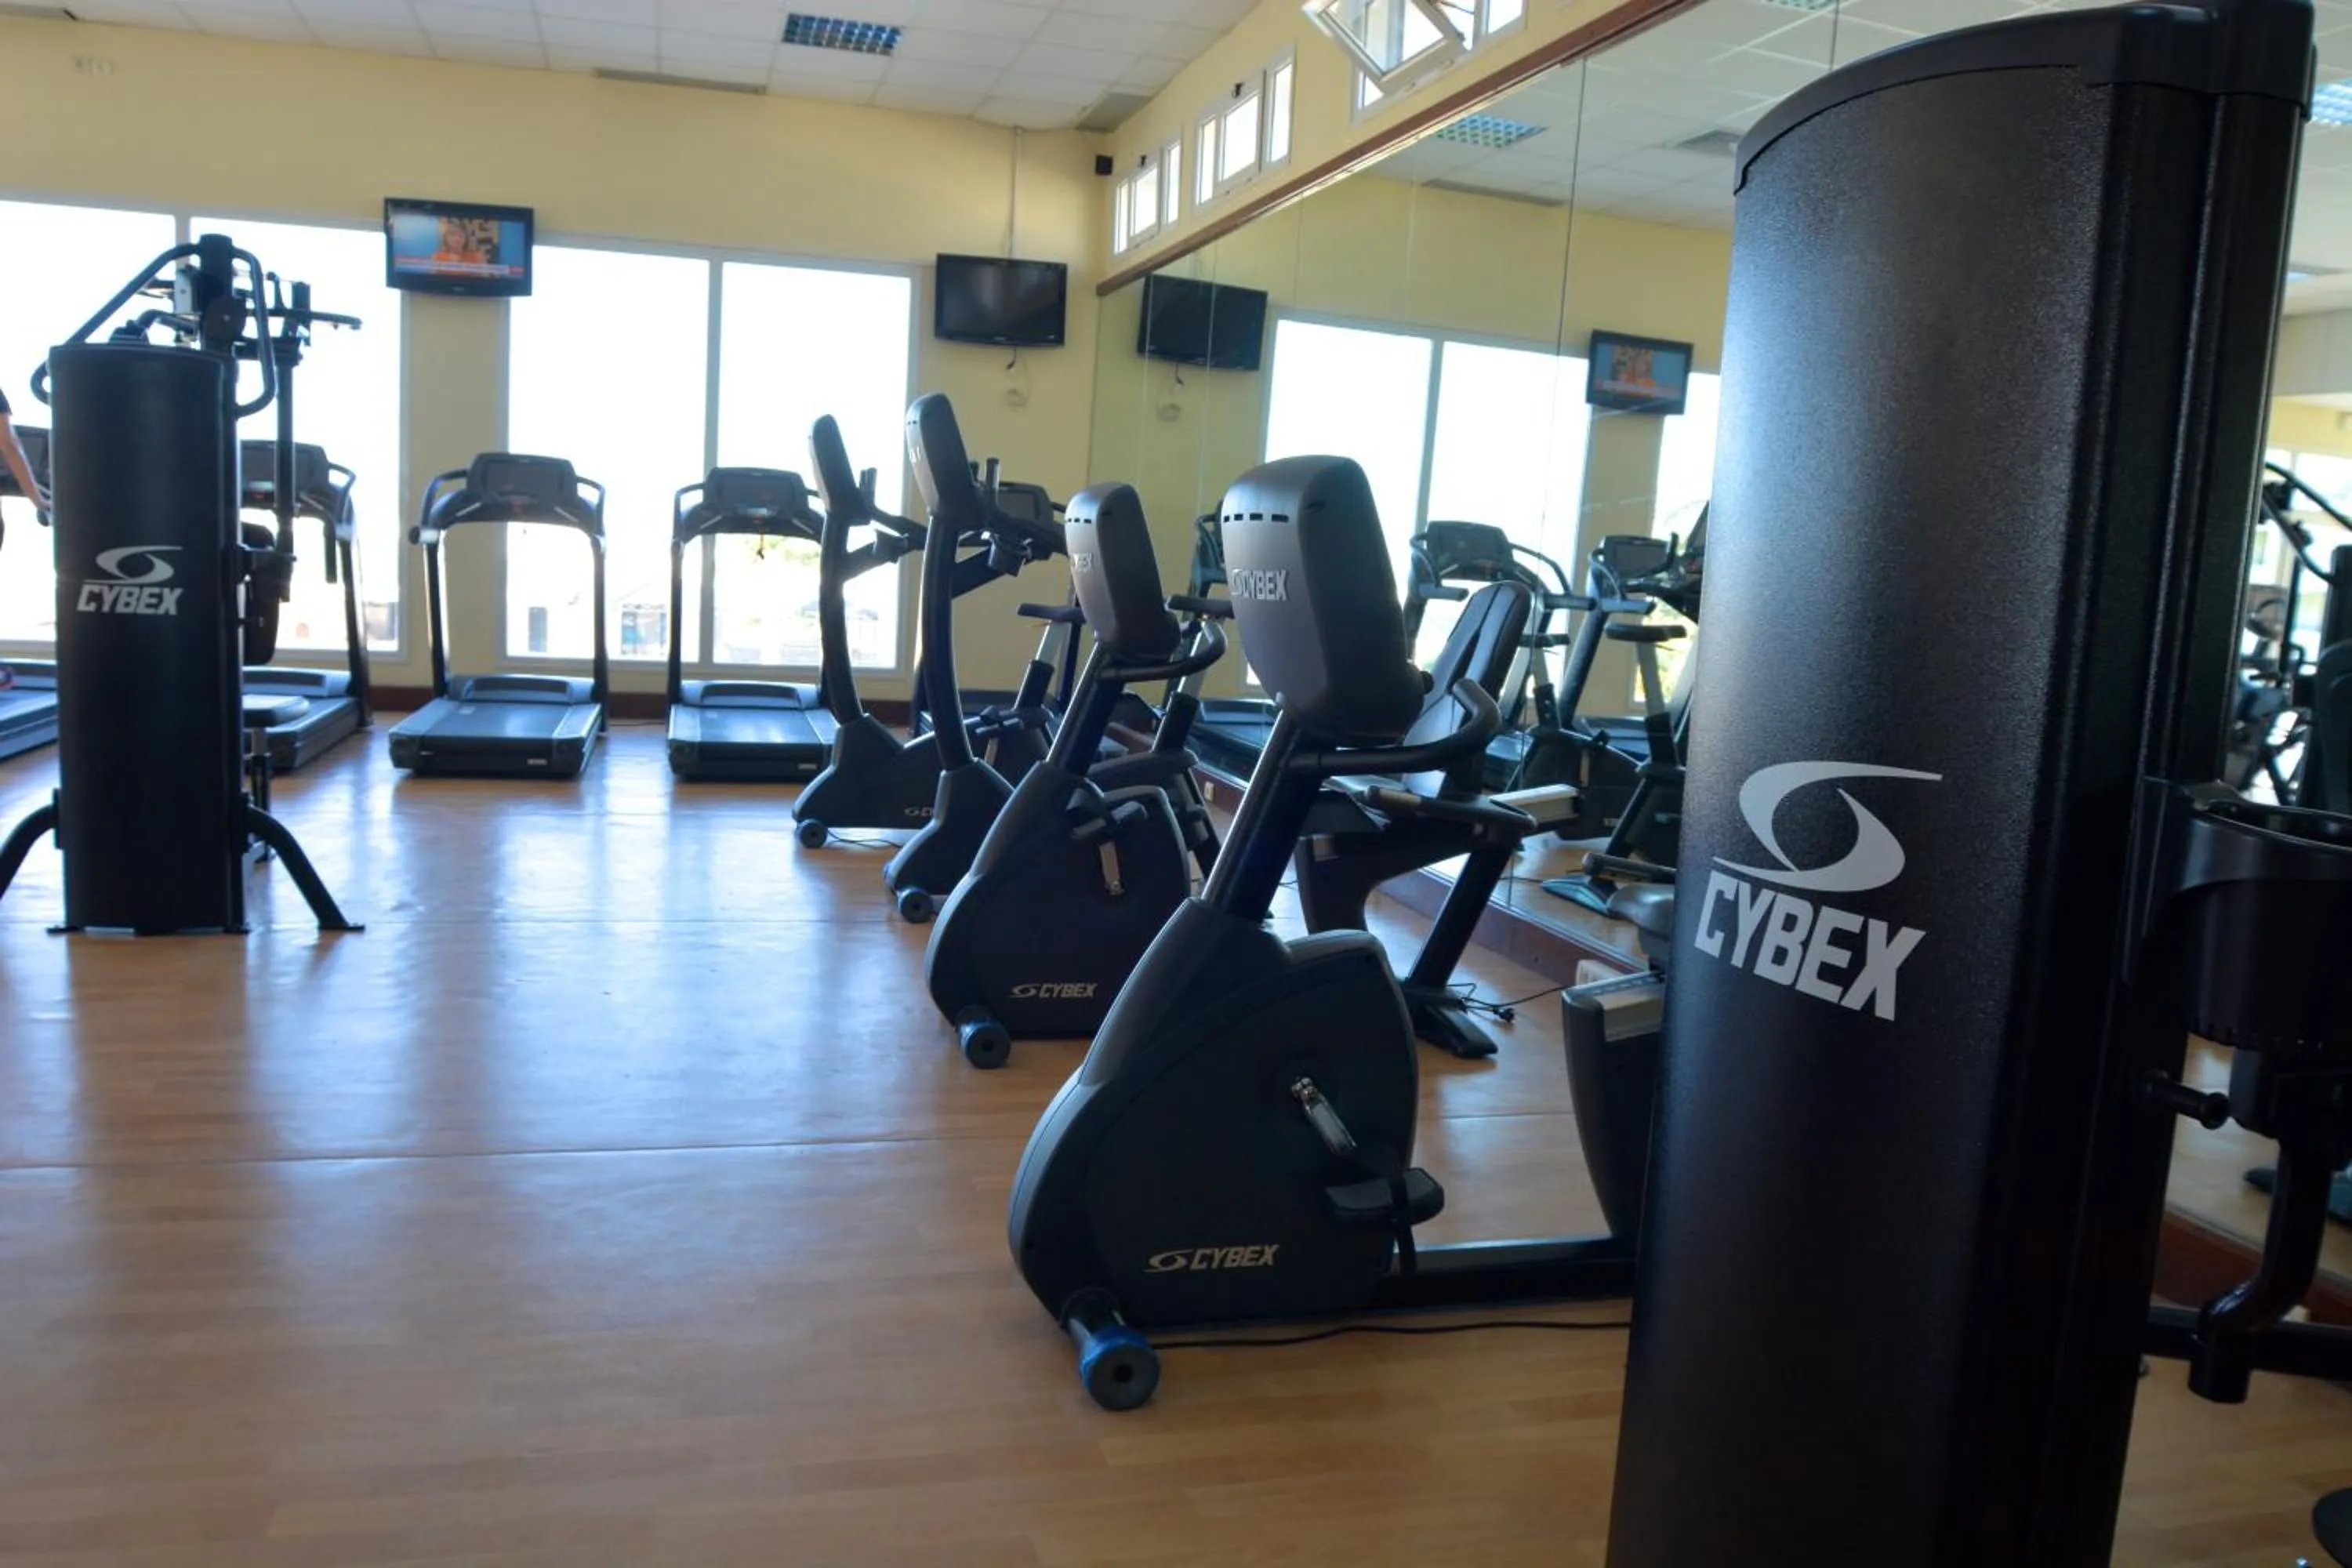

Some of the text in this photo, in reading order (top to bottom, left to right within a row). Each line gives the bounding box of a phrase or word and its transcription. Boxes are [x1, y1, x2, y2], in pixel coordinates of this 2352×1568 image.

[76, 583, 183, 615] CYBEX
[1693, 869, 1926, 1022] CYBEX
[1039, 982, 1097, 998] CYBEX
[1190, 1244, 1279, 1270] CYBEX
